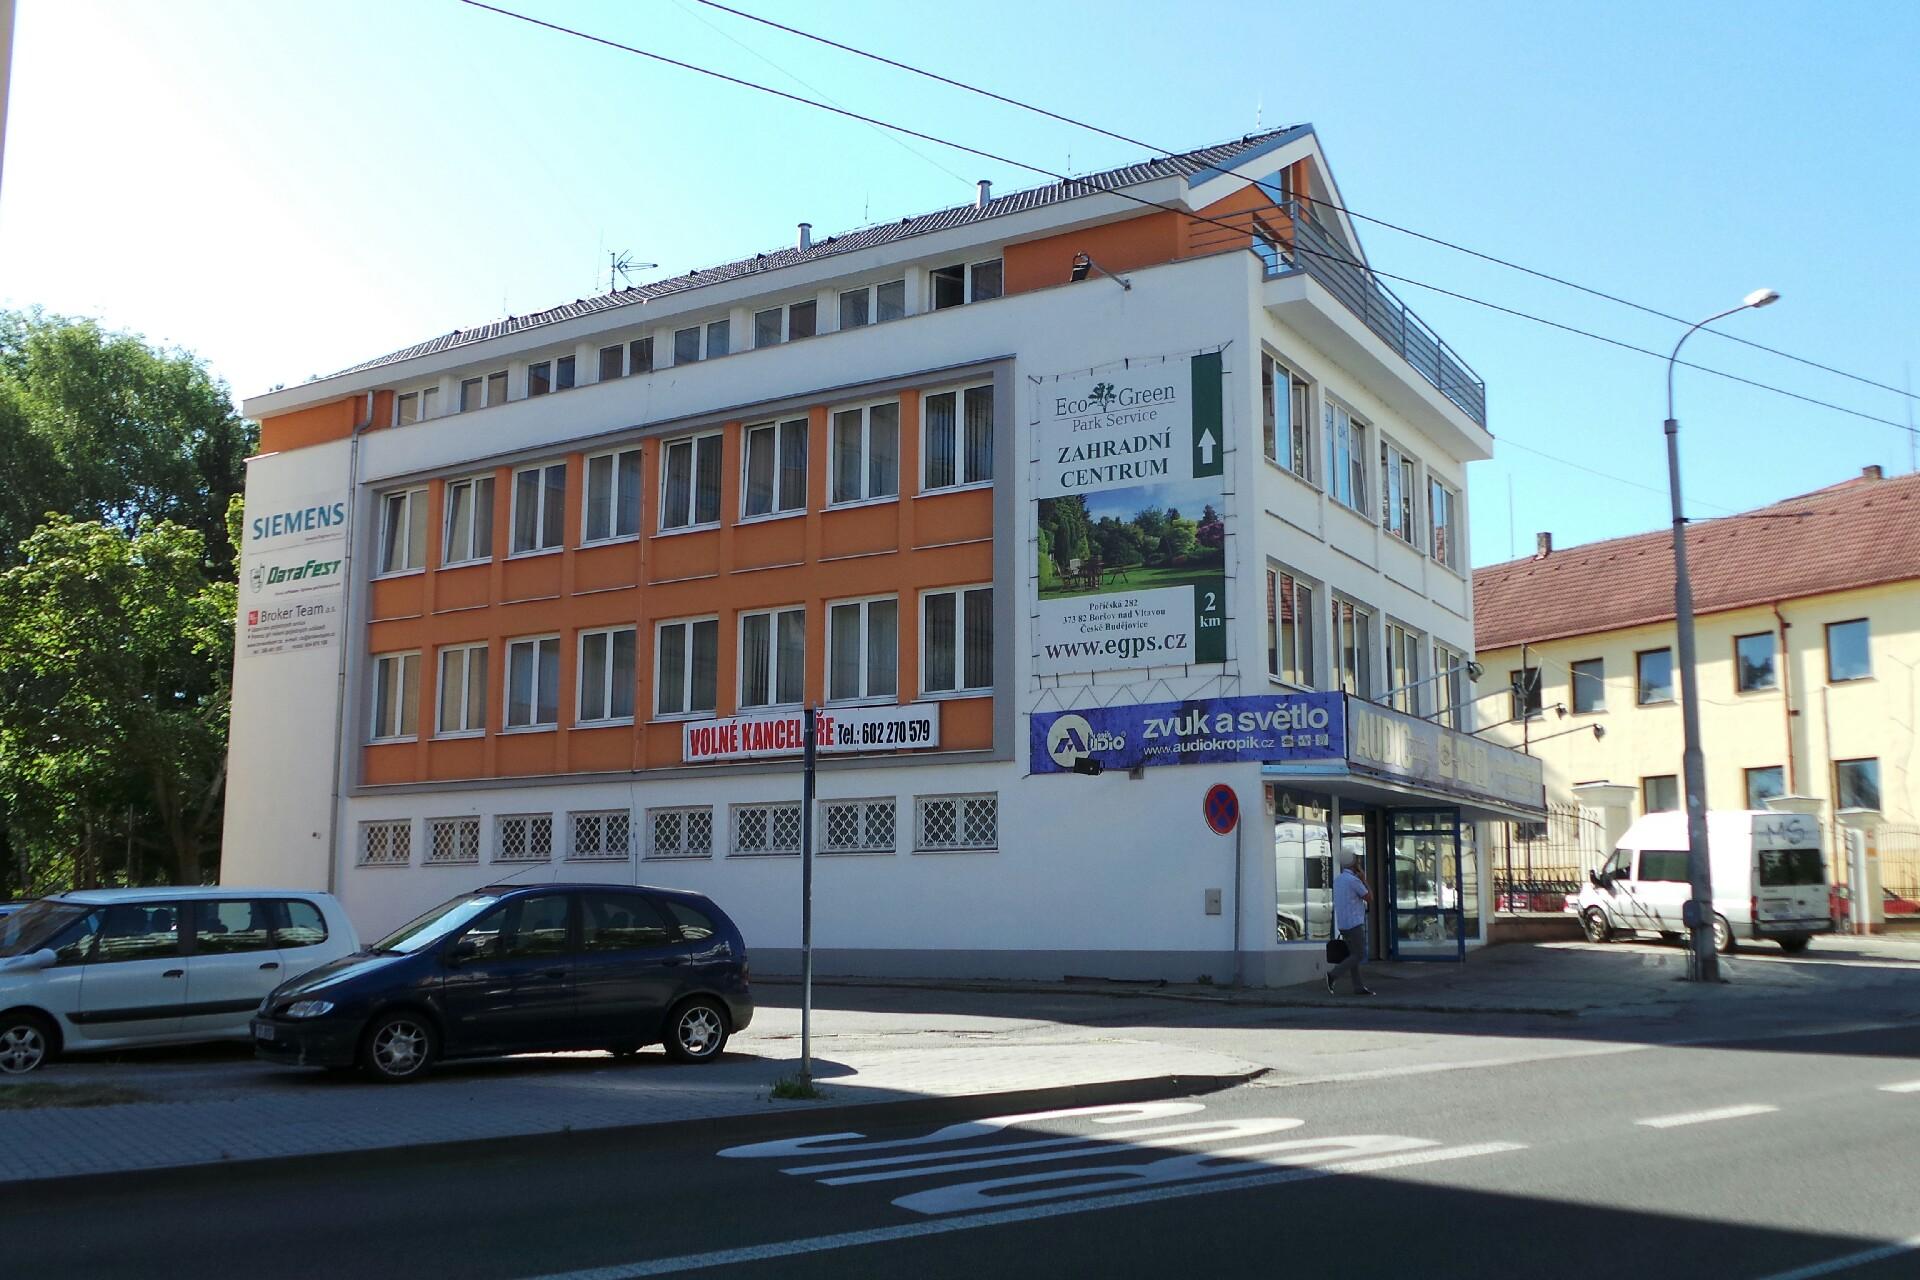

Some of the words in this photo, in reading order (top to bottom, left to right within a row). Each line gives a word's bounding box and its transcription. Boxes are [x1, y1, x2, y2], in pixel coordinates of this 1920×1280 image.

[1055, 397, 1088, 416] Eco
[1118, 385, 1176, 406] Green
[1072, 416, 1102, 432] Park
[1106, 409, 1157, 427] Service
[1058, 426, 1171, 464] ZAHRADNÍ
[1060, 457, 1168, 488] CENTRUM
[252, 502, 345, 540] SIEMENS
[1124, 599, 1138, 608] 282
[1204, 592, 1216, 611] 2
[261, 607, 293, 623] Broker
[296, 604, 324, 617] Team
[1063, 616, 1076, 624] 373
[1078, 614, 1087, 622] 82
[1089, 612, 1115, 622] Boršov
[1118, 609, 1133, 619] nad
[1134, 608, 1166, 617] Vltavou
[1200, 615, 1221, 628] km
[1080, 623, 1104, 633] České
[1105, 620, 1149, 631] Budějovice
[1045, 632, 1187, 659] www.egps.cz
[1143, 709, 1210, 739] zvuk
[1216, 714, 1234, 733] a
[1238, 703, 1329, 731] světlo
[690, 719, 738, 756] VOLNÉ
[742, 710, 835, 750] KANCELŘE
[838, 723, 860, 745] Tel.:
[862, 722, 884, 745] 602
[886, 721, 907, 744] 270
[908, 719, 930, 741] 579
[1143, 737, 1275, 757] www.audiokropik.cz
